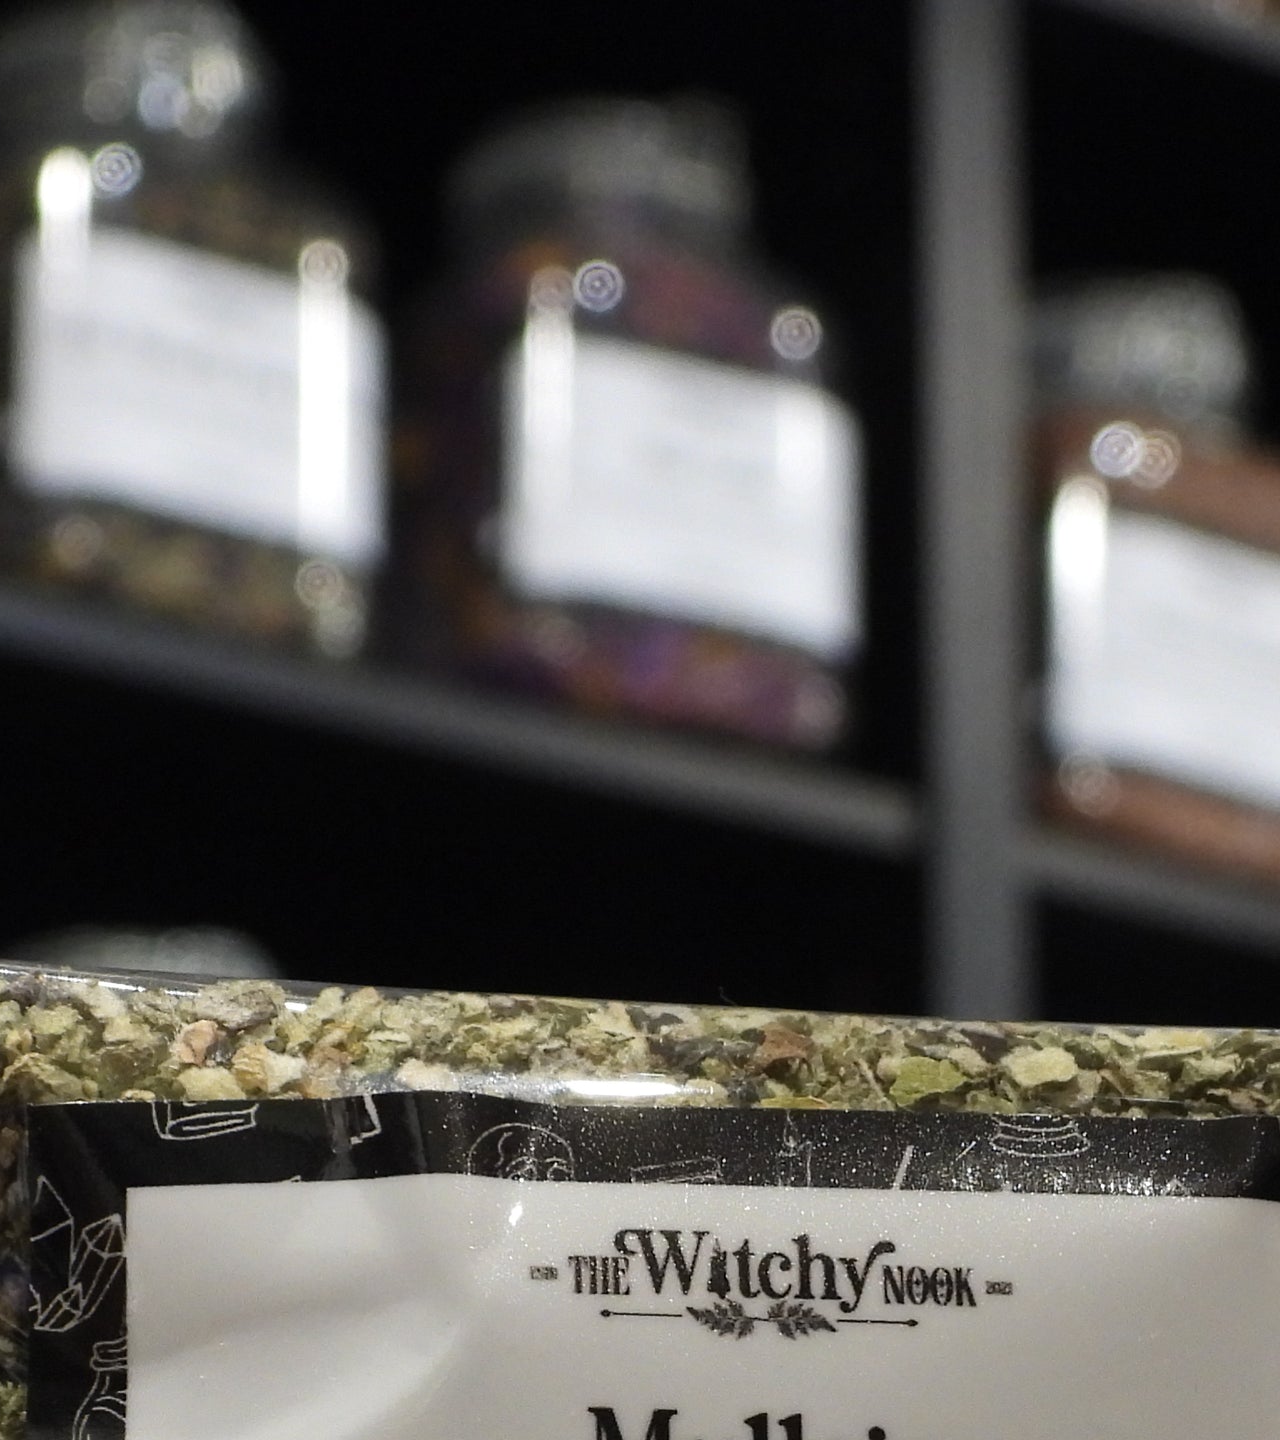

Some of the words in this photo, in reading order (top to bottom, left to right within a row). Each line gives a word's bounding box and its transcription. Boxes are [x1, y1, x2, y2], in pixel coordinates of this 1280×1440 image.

[568, 1254, 631, 1296] THE
[613, 1228, 897, 1314] Witchy
[882, 1264, 978, 1308] NOOK
